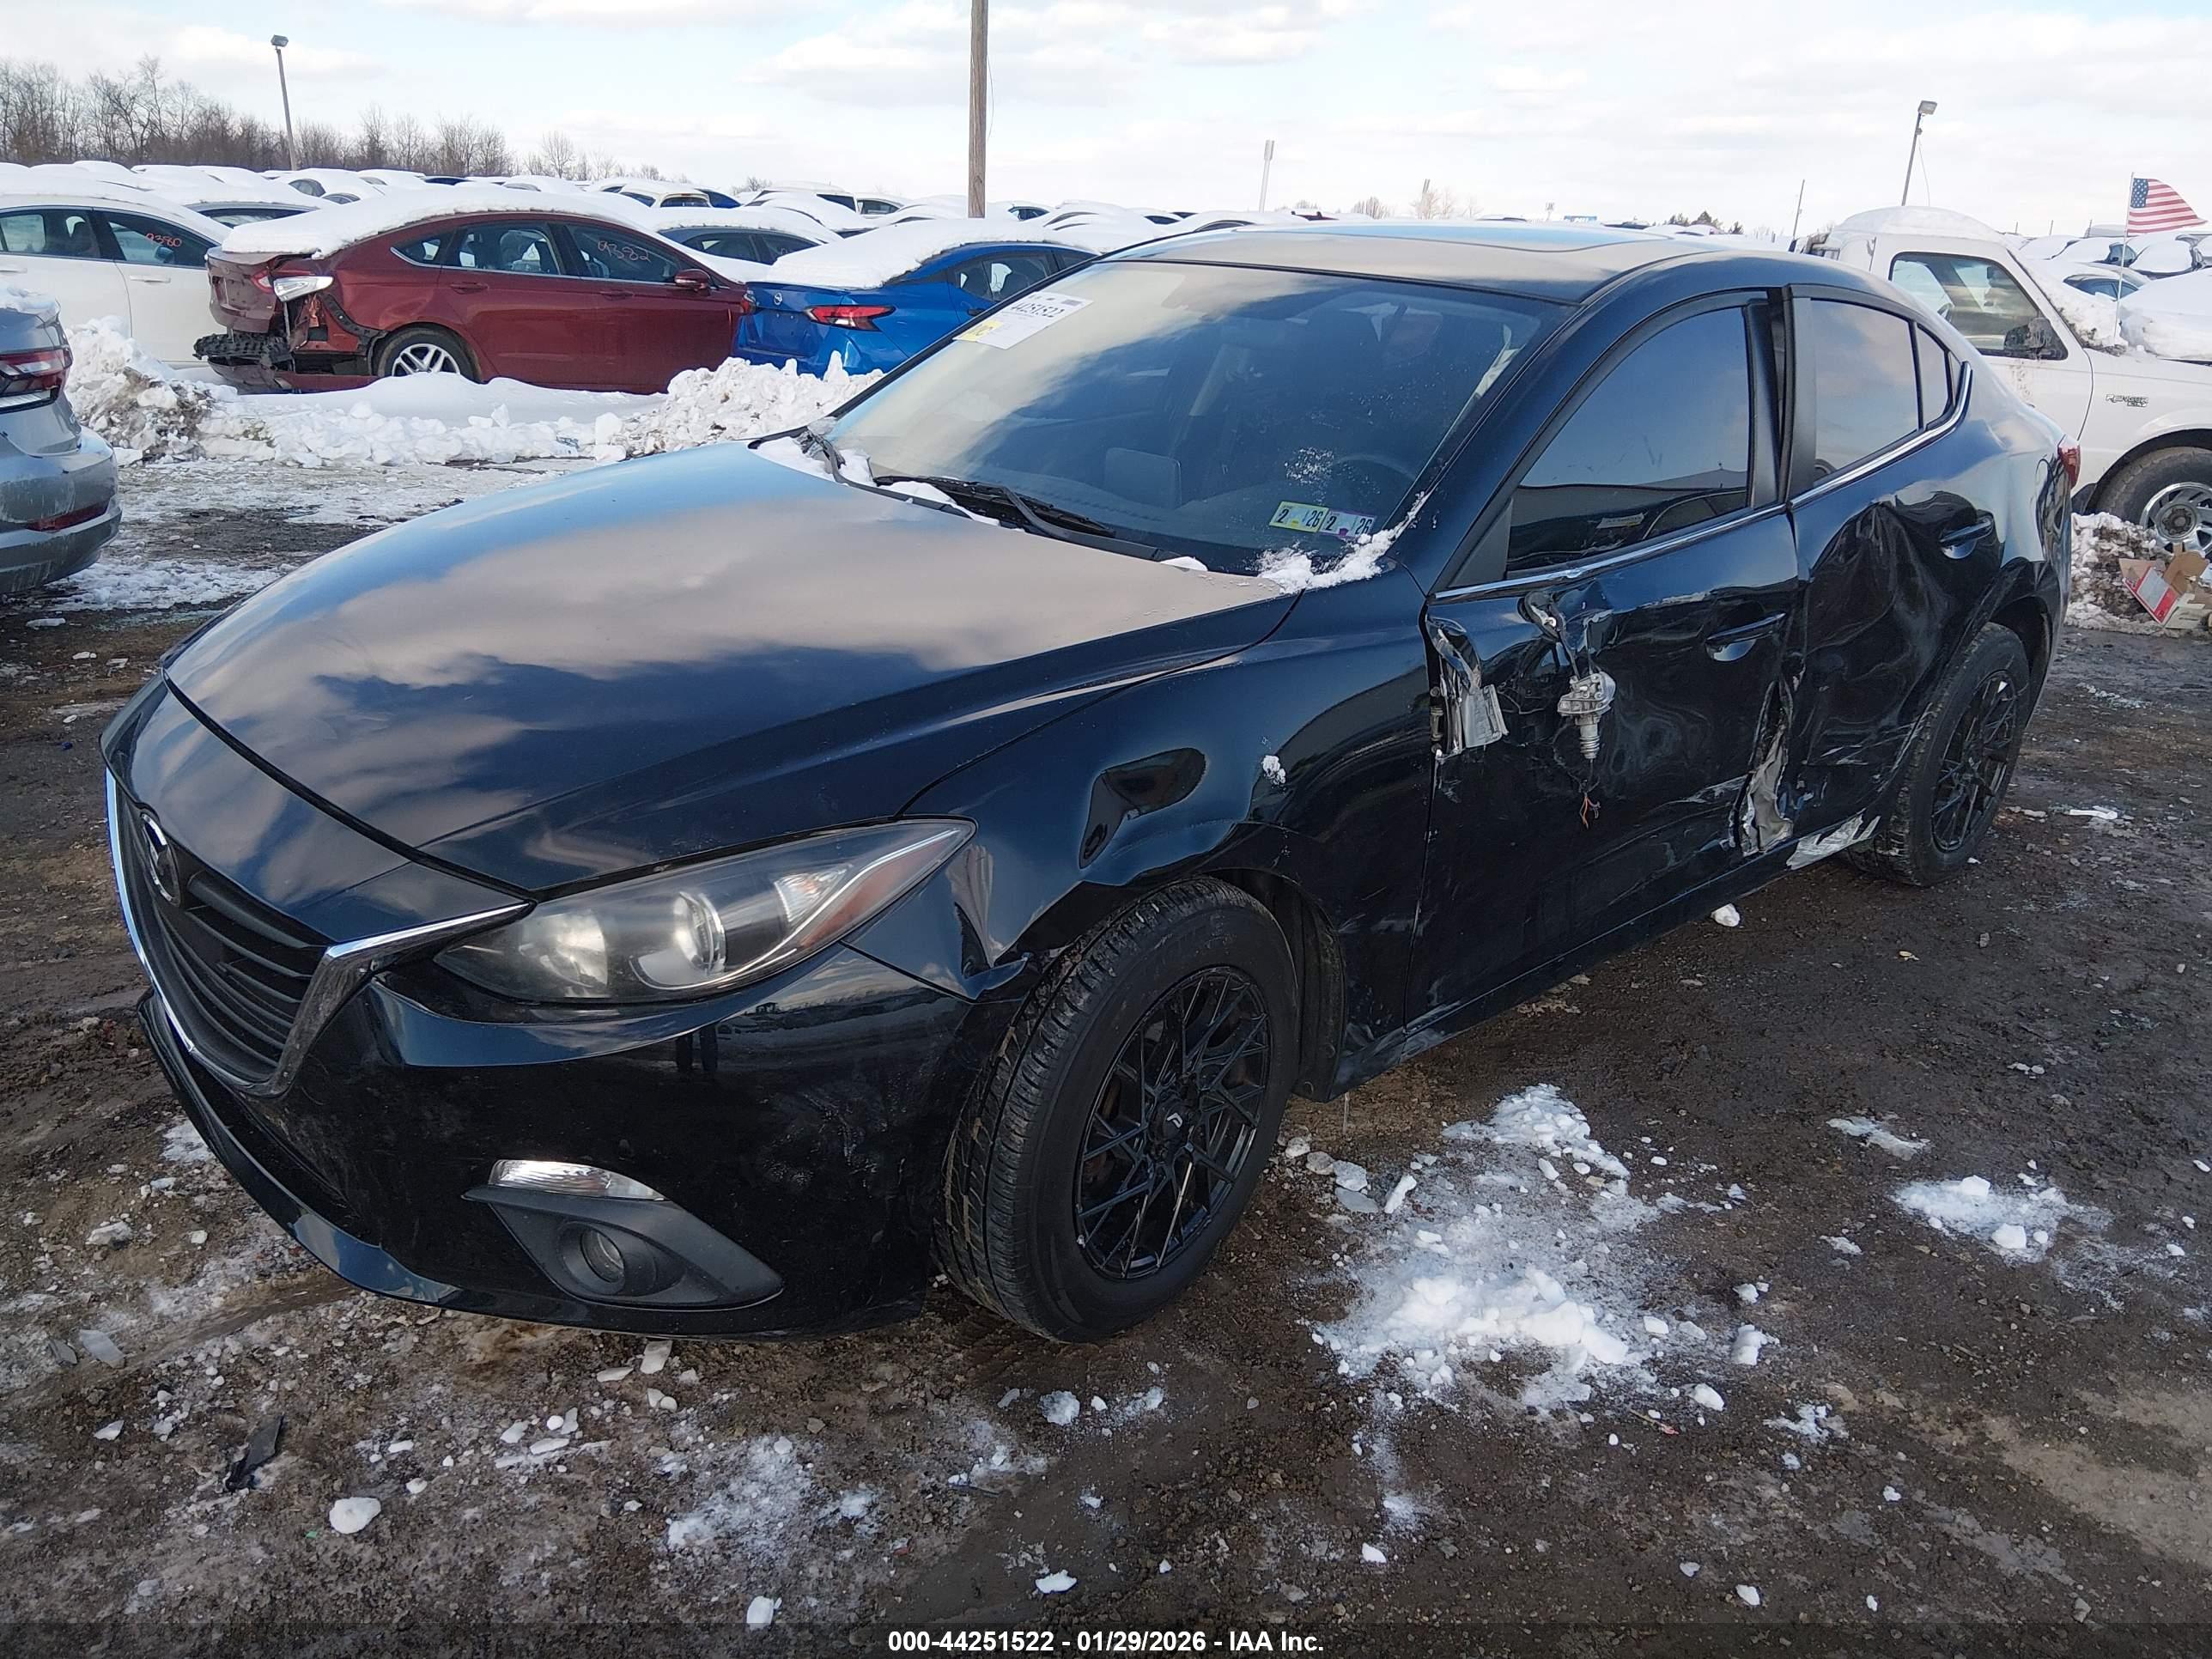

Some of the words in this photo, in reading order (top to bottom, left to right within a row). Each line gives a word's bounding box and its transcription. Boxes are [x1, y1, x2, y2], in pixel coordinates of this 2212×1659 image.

[1276, 508, 1289, 523] 2
[1305, 509, 1324, 528] 26
[1325, 515, 1337, 531] 2
[1355, 518, 1373, 535] 26
